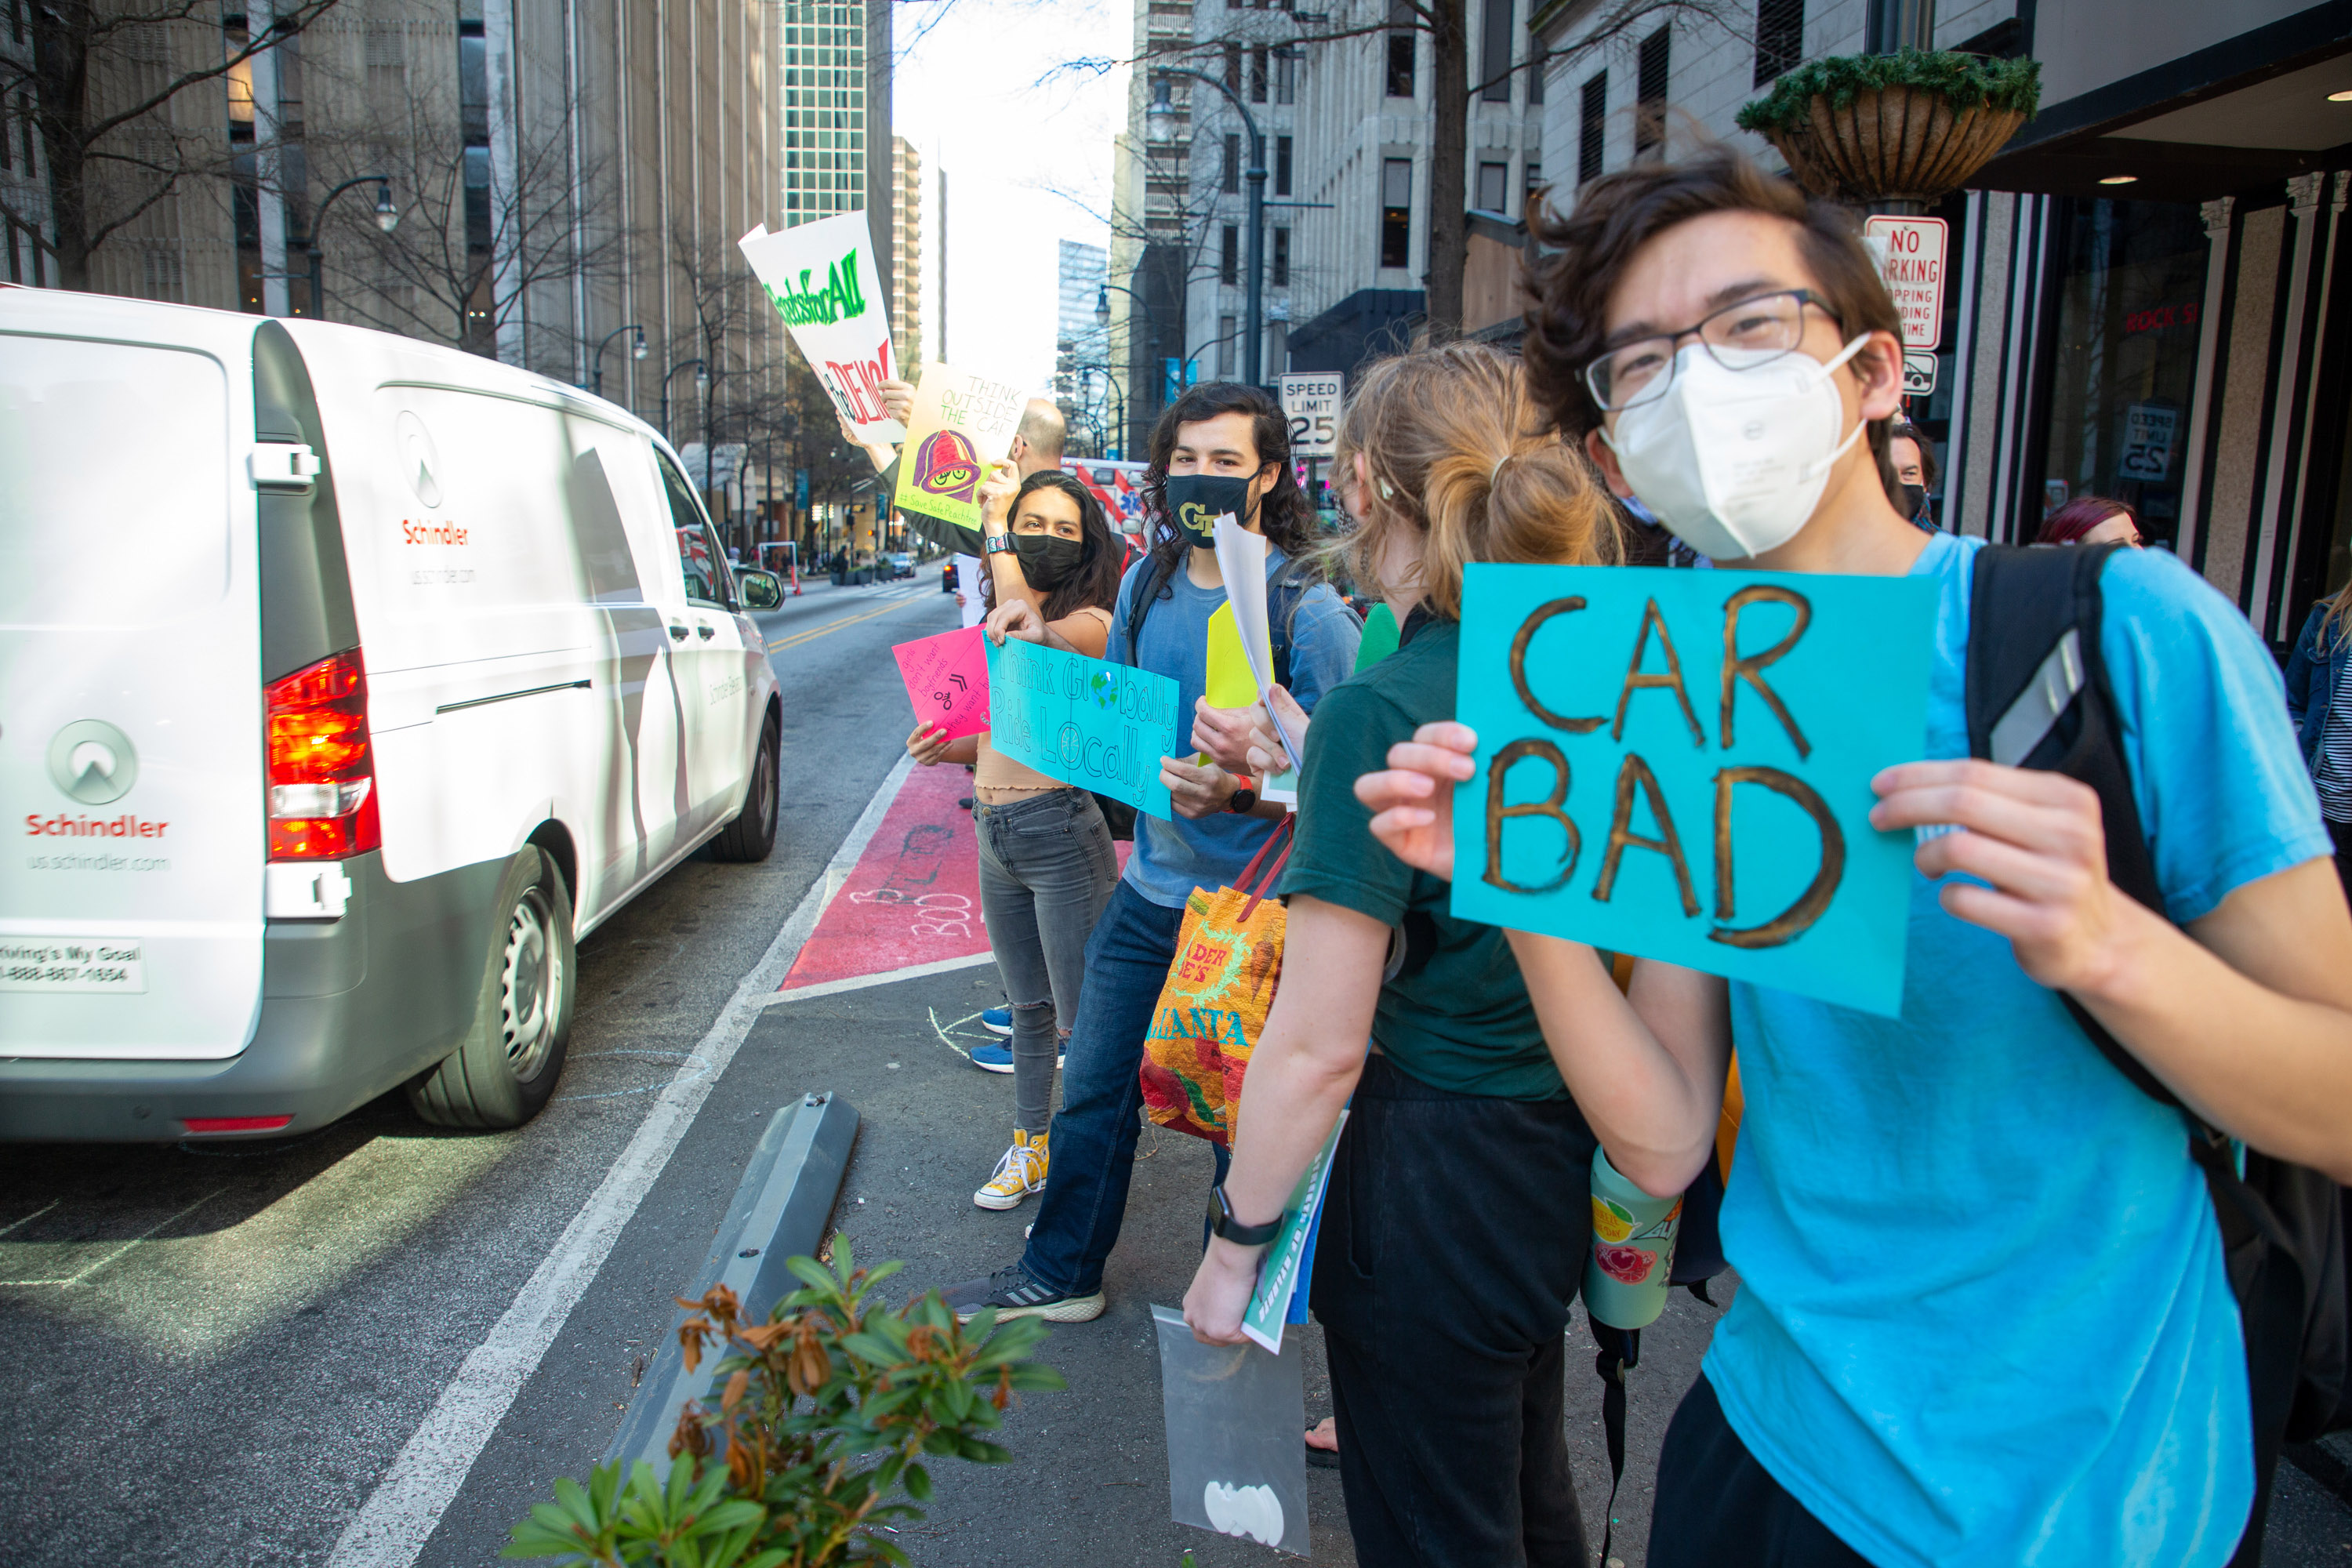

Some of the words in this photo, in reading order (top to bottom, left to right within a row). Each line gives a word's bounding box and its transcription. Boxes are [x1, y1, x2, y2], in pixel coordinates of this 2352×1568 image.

[1891, 230, 1919, 252] NO
[1882, 259, 1937, 282] RKING
[1895, 307, 1929, 319] NDING
[2126, 307, 2176, 332] ROCK
[1903, 323, 1926, 336] TIME
[968, 376, 1022, 406] THINK
[1287, 383, 1337, 396] SPEED
[942, 389, 1017, 423] OUTSIDE
[1292, 400, 1331, 412] LIMIT
[941, 405, 967, 425] THE
[978, 417, 1011, 437] CAR
[1290, 417, 1336, 445] 25
[402, 519, 468, 546] Schindler
[1179, 502, 1221, 537] GT
[902, 648, 916, 672] girls
[909, 666, 924, 689] don't
[924, 641, 941, 666] want
[985, 634, 1054, 695] Think
[1510, 585, 1812, 760] CAR
[918, 658, 948, 697] boyfriends
[947, 713, 967, 732] they
[964, 689, 981, 712] want
[992, 687, 1030, 753] Ride
[24, 814, 169, 837] Schindler
[1482, 738, 1846, 949] BAD
[66, 946, 93, 964] My
[96, 946, 141, 961] Goal
[1187, 942, 1228, 966] DER
